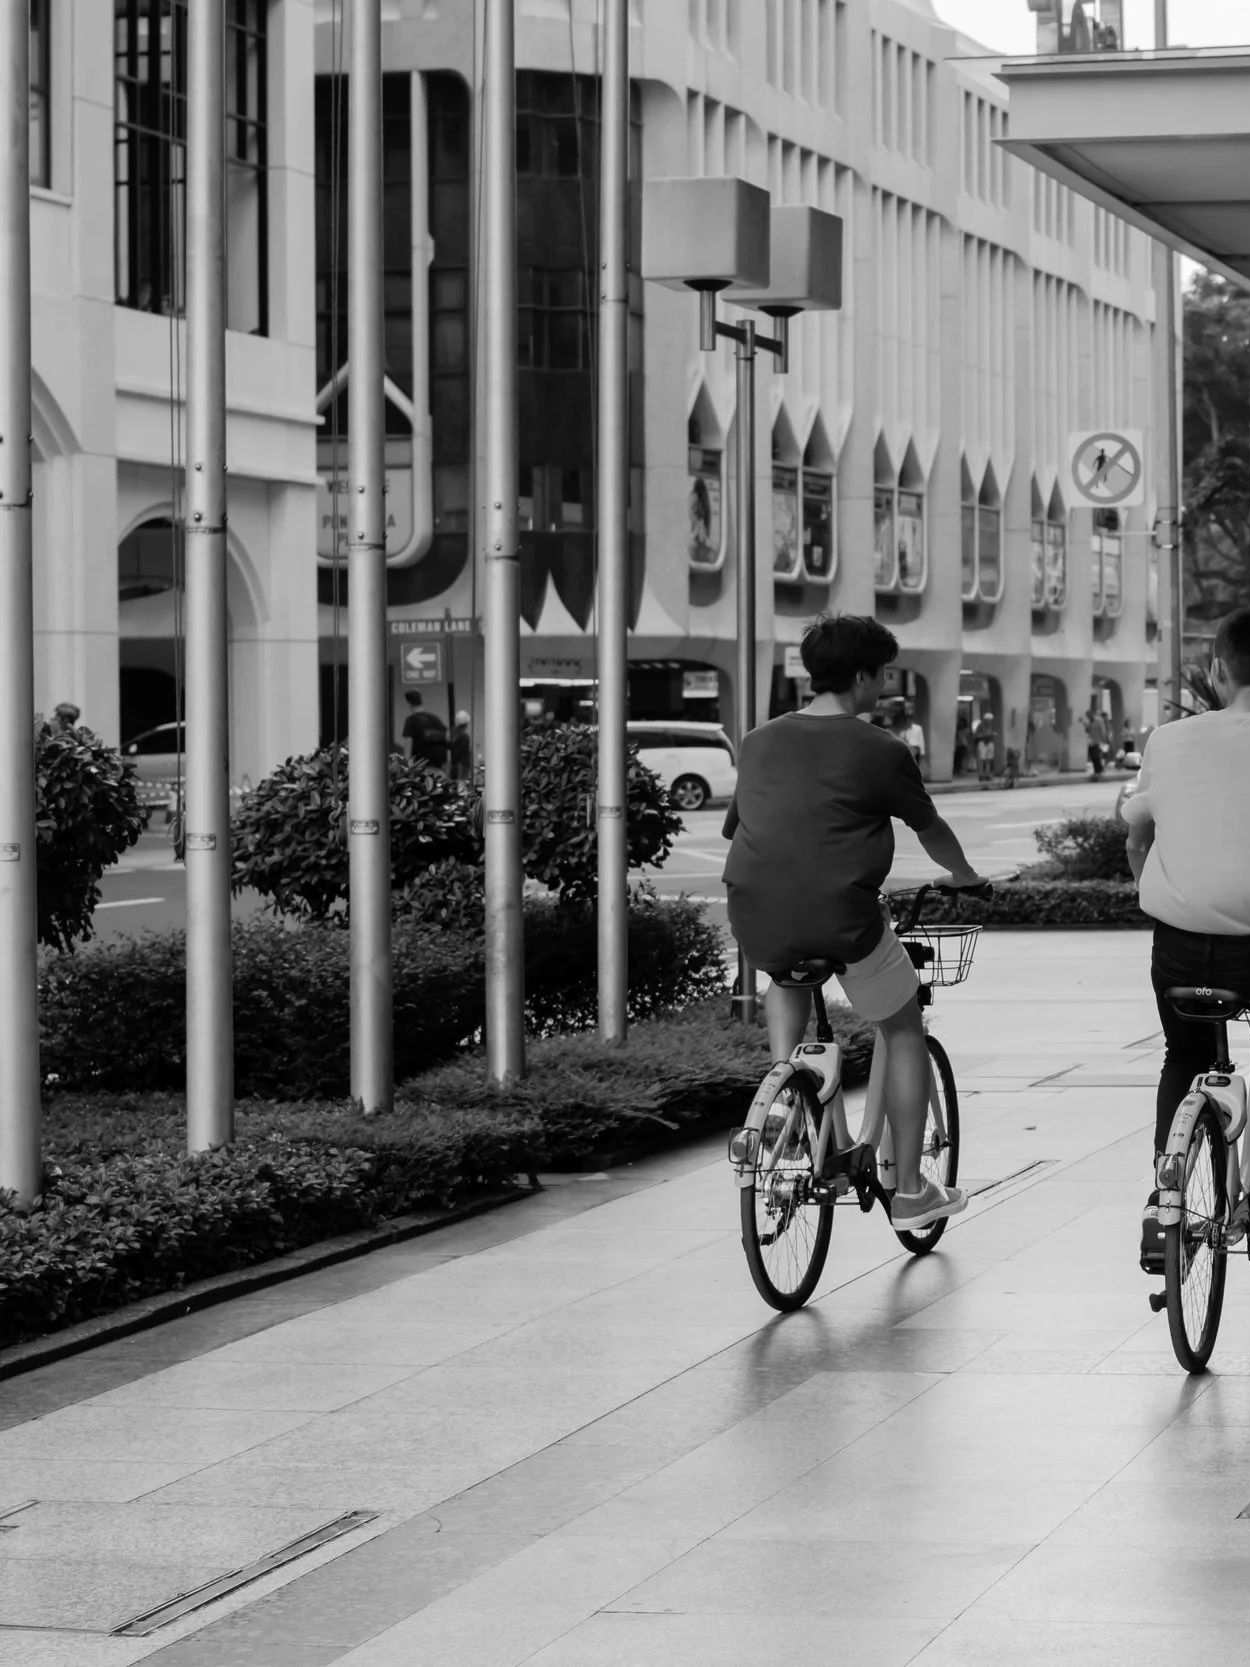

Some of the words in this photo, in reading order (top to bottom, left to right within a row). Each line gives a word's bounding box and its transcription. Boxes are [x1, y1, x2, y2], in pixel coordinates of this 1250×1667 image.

[391, 621, 441, 634] COLEMAN
[445, 620, 471, 632] LANE
[1195, 986, 1212, 996] ofo
